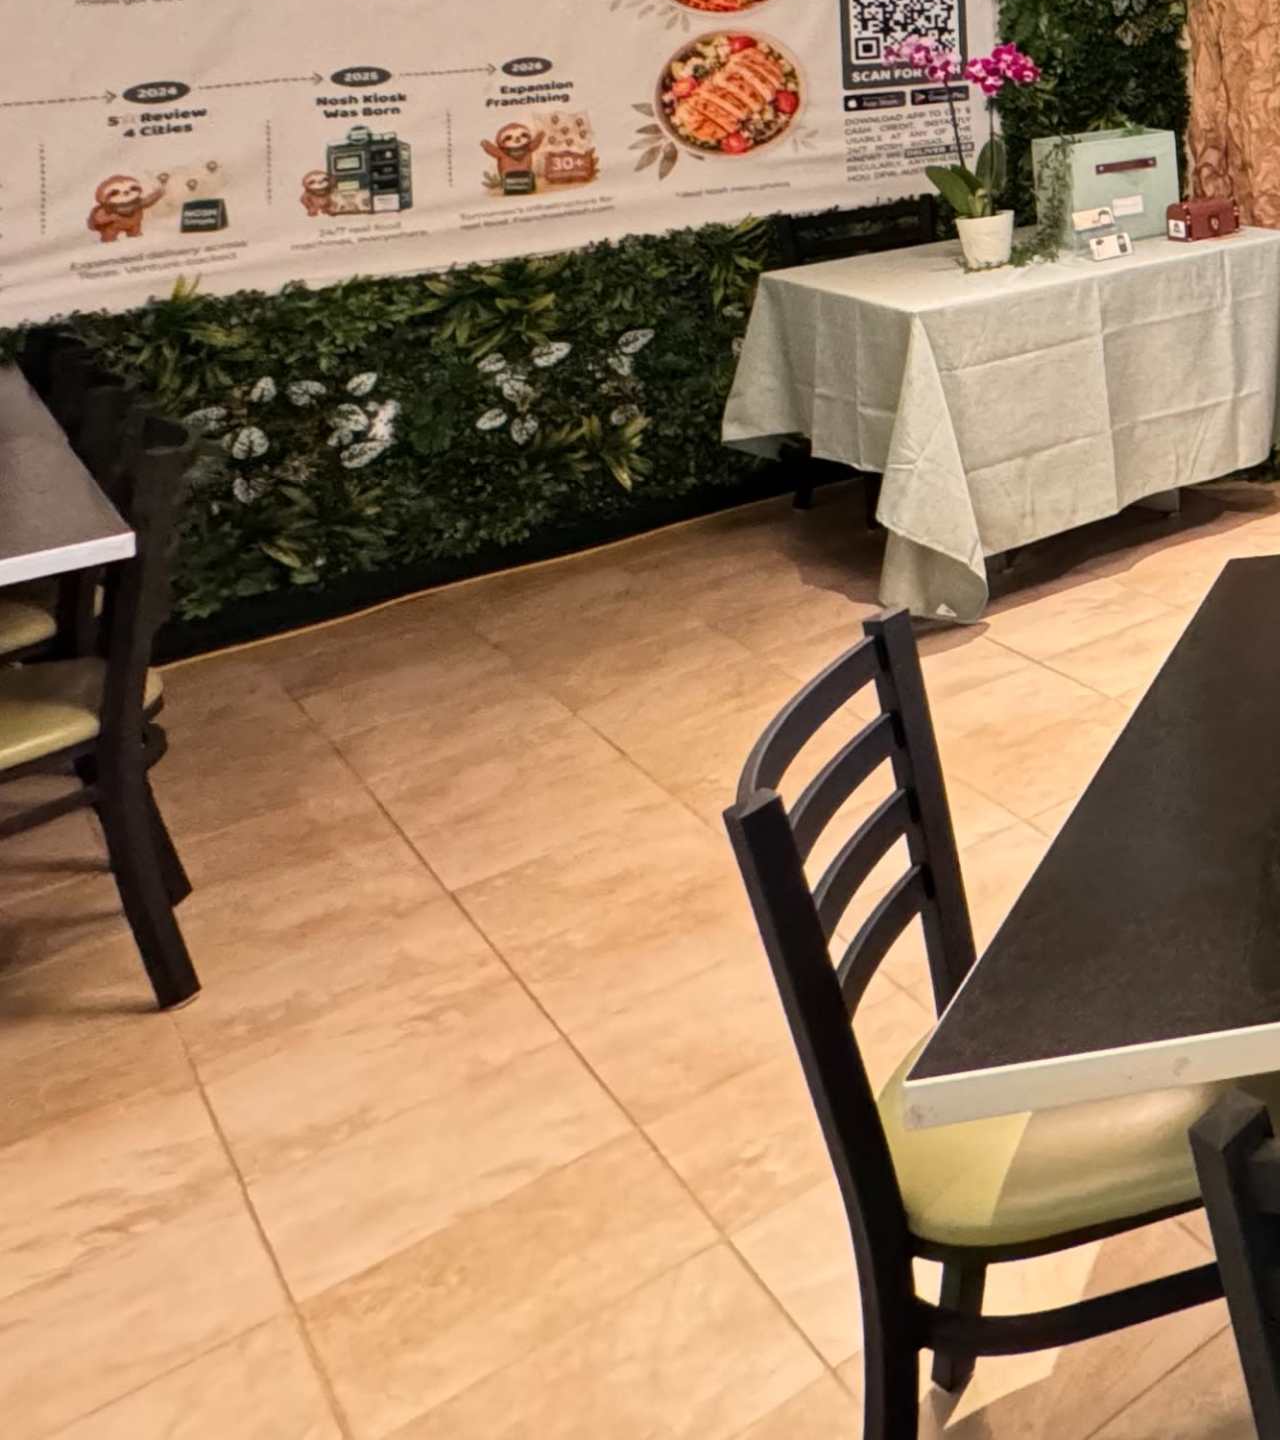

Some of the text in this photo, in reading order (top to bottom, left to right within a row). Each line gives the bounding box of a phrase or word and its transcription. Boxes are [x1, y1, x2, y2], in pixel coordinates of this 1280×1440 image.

[343, 71, 379, 83] 2025
[851, 69, 891, 82] SCAN
[894, 68, 921, 80] FOR
[136, 86, 179, 100] 2024
[500, 80, 574, 95] Expansion
[315, 92, 408, 107] Nosh Kiosk
[485, 92, 571, 108] Franchising
[107, 108, 208, 127] 5 Review
[323, 106, 401, 119] Was Born
[123, 122, 193, 138] 4 Cities
[552, 156, 584, 171] 30+
